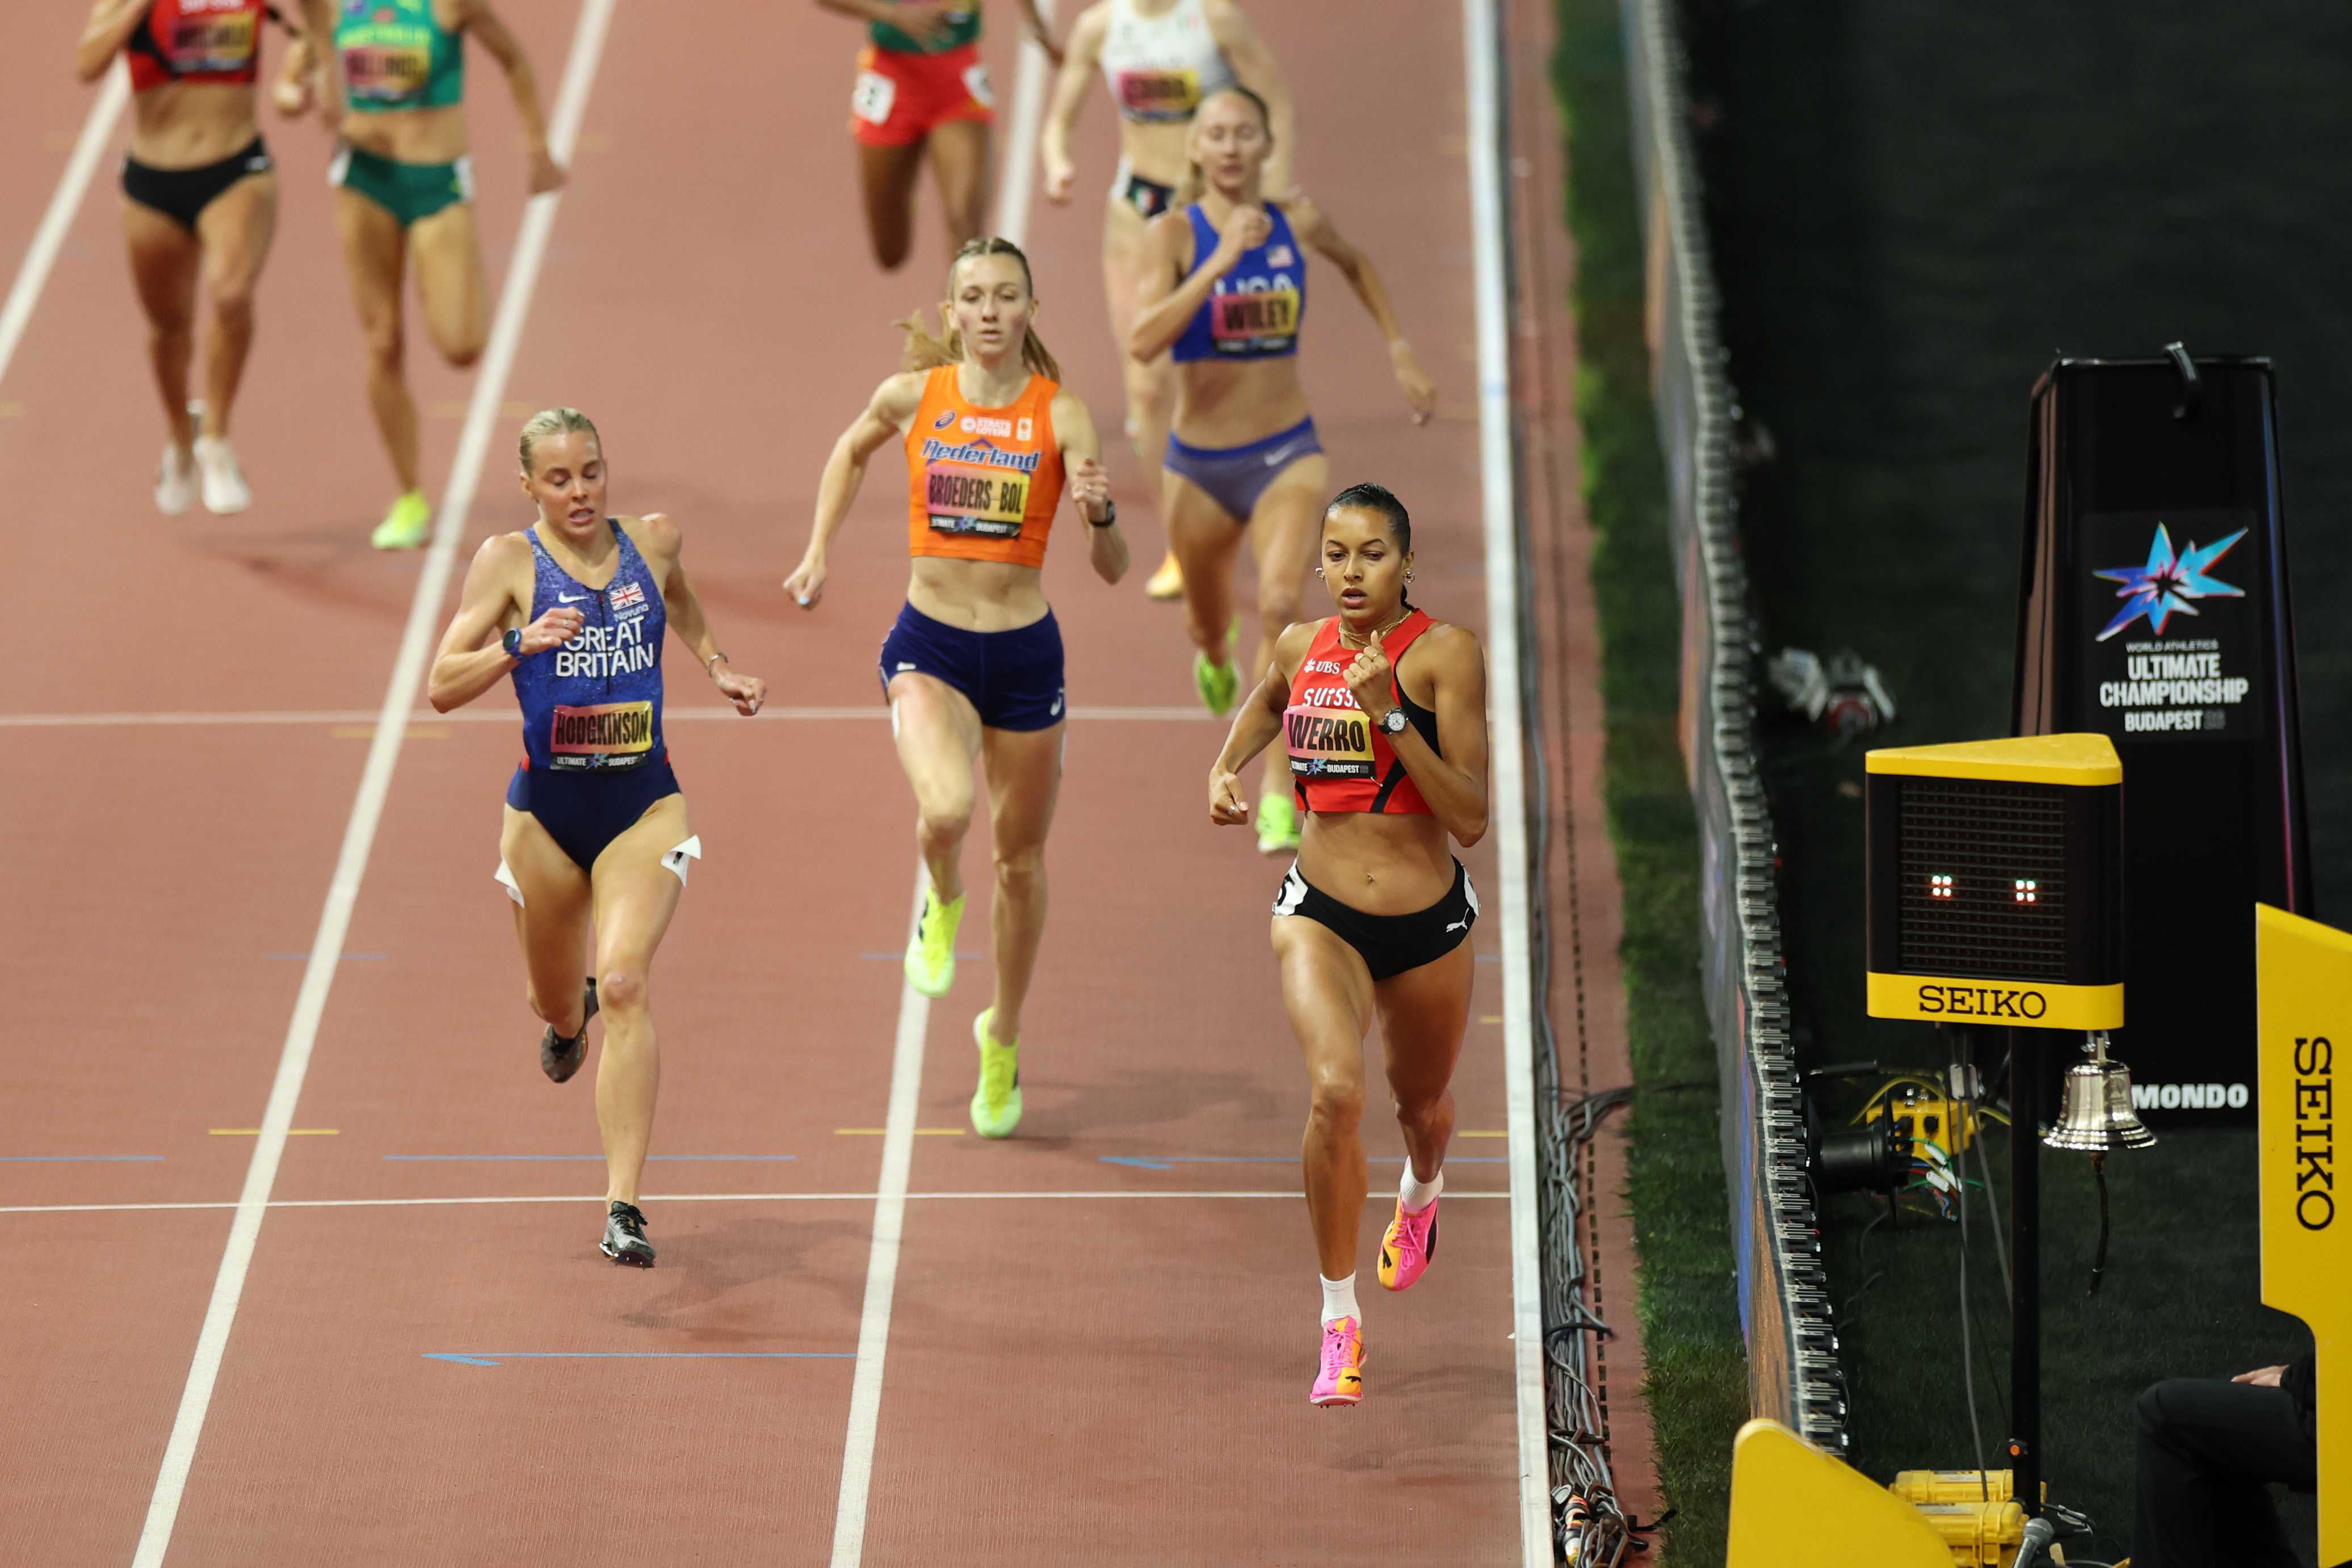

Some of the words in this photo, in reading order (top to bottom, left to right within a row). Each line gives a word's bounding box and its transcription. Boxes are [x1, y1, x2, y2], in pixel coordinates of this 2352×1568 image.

[1223, 298, 1290, 330] WILEY
[922, 439, 1041, 470] Nederland
[929, 474, 992, 510] BROEDERS
[999, 482, 1023, 514] BOL
[564, 615, 645, 651] GREAT
[2126, 640, 2163, 653] WORLD
[2164, 638, 2219, 651] ATHLETICS
[556, 642, 653, 678] BRITAIN
[1316, 661, 1341, 674] UBS
[2128, 653, 2221, 680] ULTIMATE
[2099, 678, 2249, 707] CHAMPIONSHIP
[555, 711, 648, 746] HODGKINSON
[1288, 714, 1366, 753] WERRO
[2124, 710, 2203, 732] BUDAPEST
[557, 757, 586, 766] ULTIMATE
[608, 756, 638, 767] BUDAPEST
[1326, 764, 1359, 774] BUDAPEST
[1919, 985, 2047, 1019] SEIKO
[2131, 1083, 2249, 1109] MONDO
[2294, 1036, 2334, 1231] SEIKO
